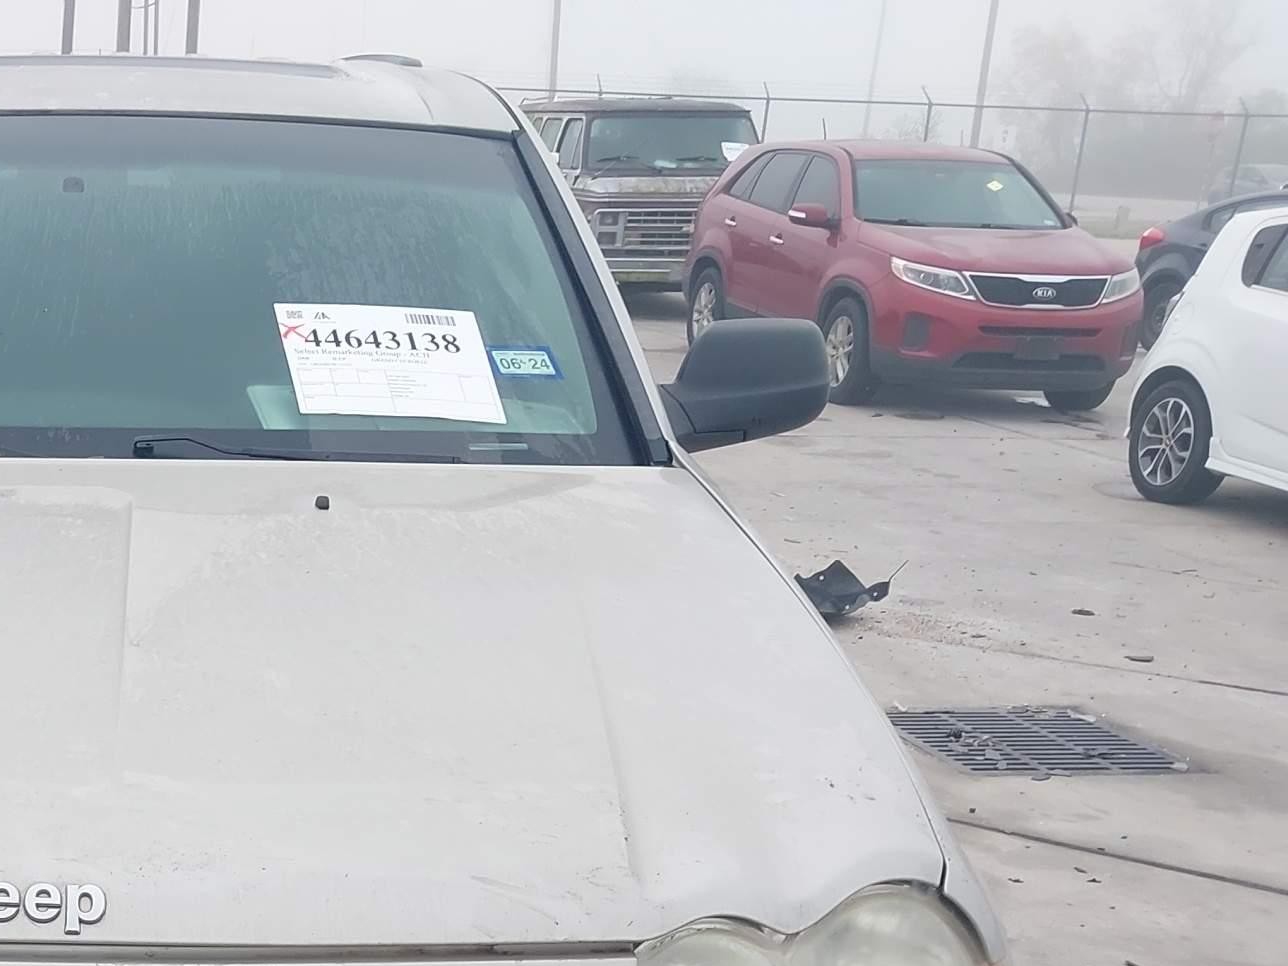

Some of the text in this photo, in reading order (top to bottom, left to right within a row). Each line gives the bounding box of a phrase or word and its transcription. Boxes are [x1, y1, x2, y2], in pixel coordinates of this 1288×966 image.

[304, 328, 461, 354] 44643138
[499, 358, 550, 370] 06 24
